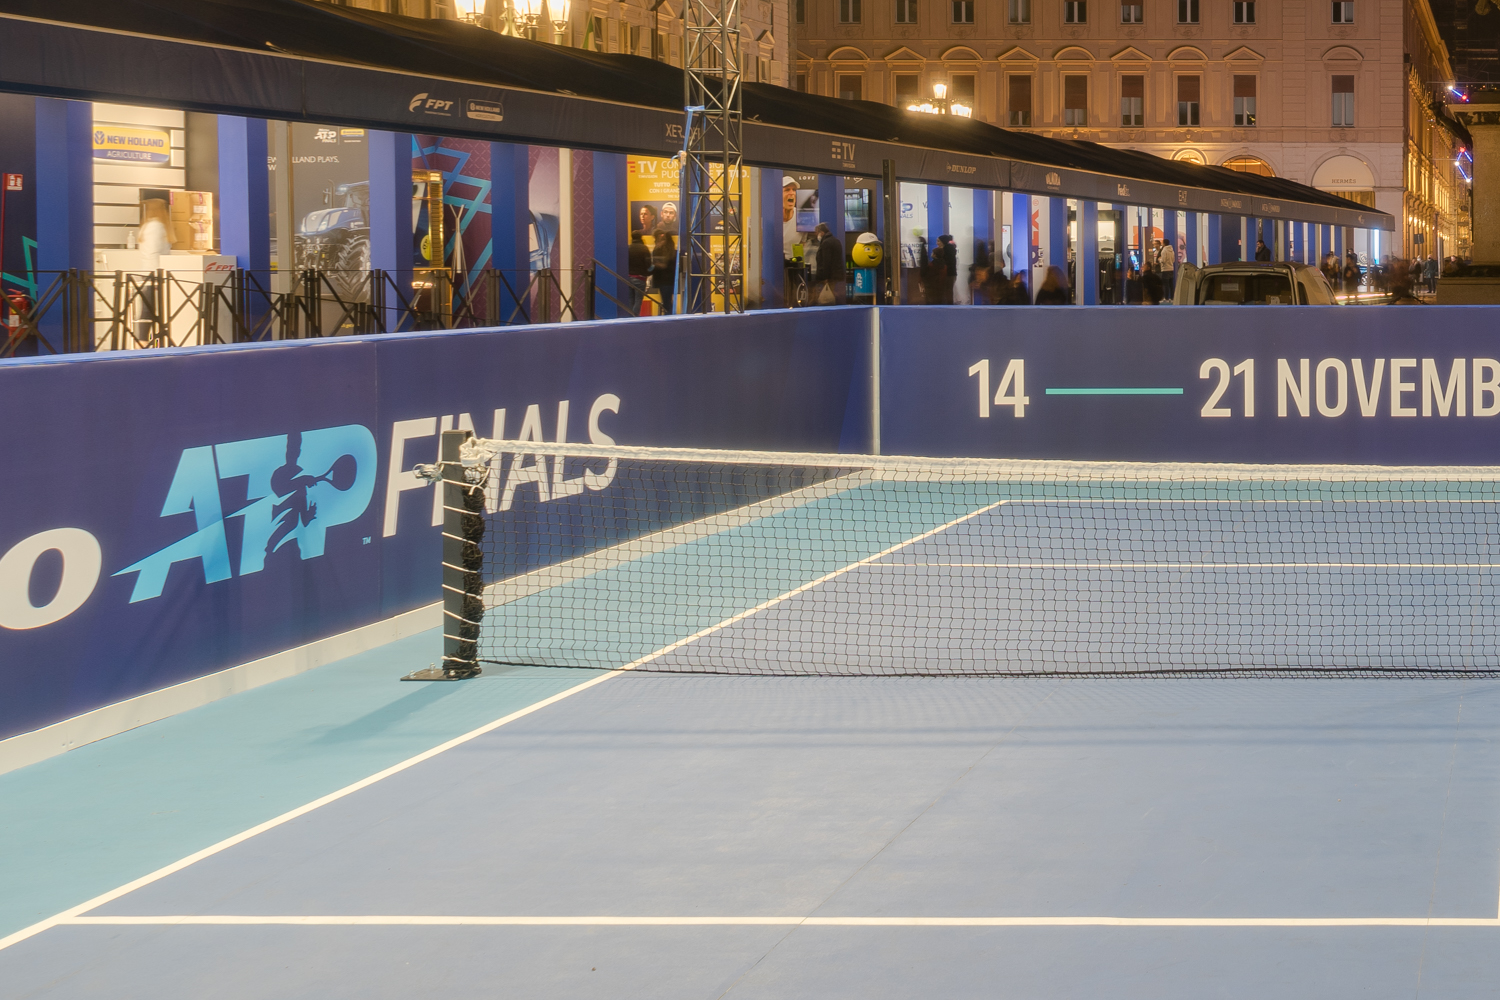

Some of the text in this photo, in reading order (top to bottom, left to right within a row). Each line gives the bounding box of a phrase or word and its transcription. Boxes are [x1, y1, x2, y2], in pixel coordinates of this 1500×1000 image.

[425, 99, 454, 111] FPT
[107, 135, 164, 148] NEW HOLLAND
[107, 150, 152, 160] AGRICULTURE
[842, 142, 855, 160] TV
[638, 161, 657, 173] TV
[951, 164, 977, 174] DUNLOP
[968, 358, 1030, 418] 14
[1199, 357, 1255, 418] 21
[111, 424, 378, 604] ATP
